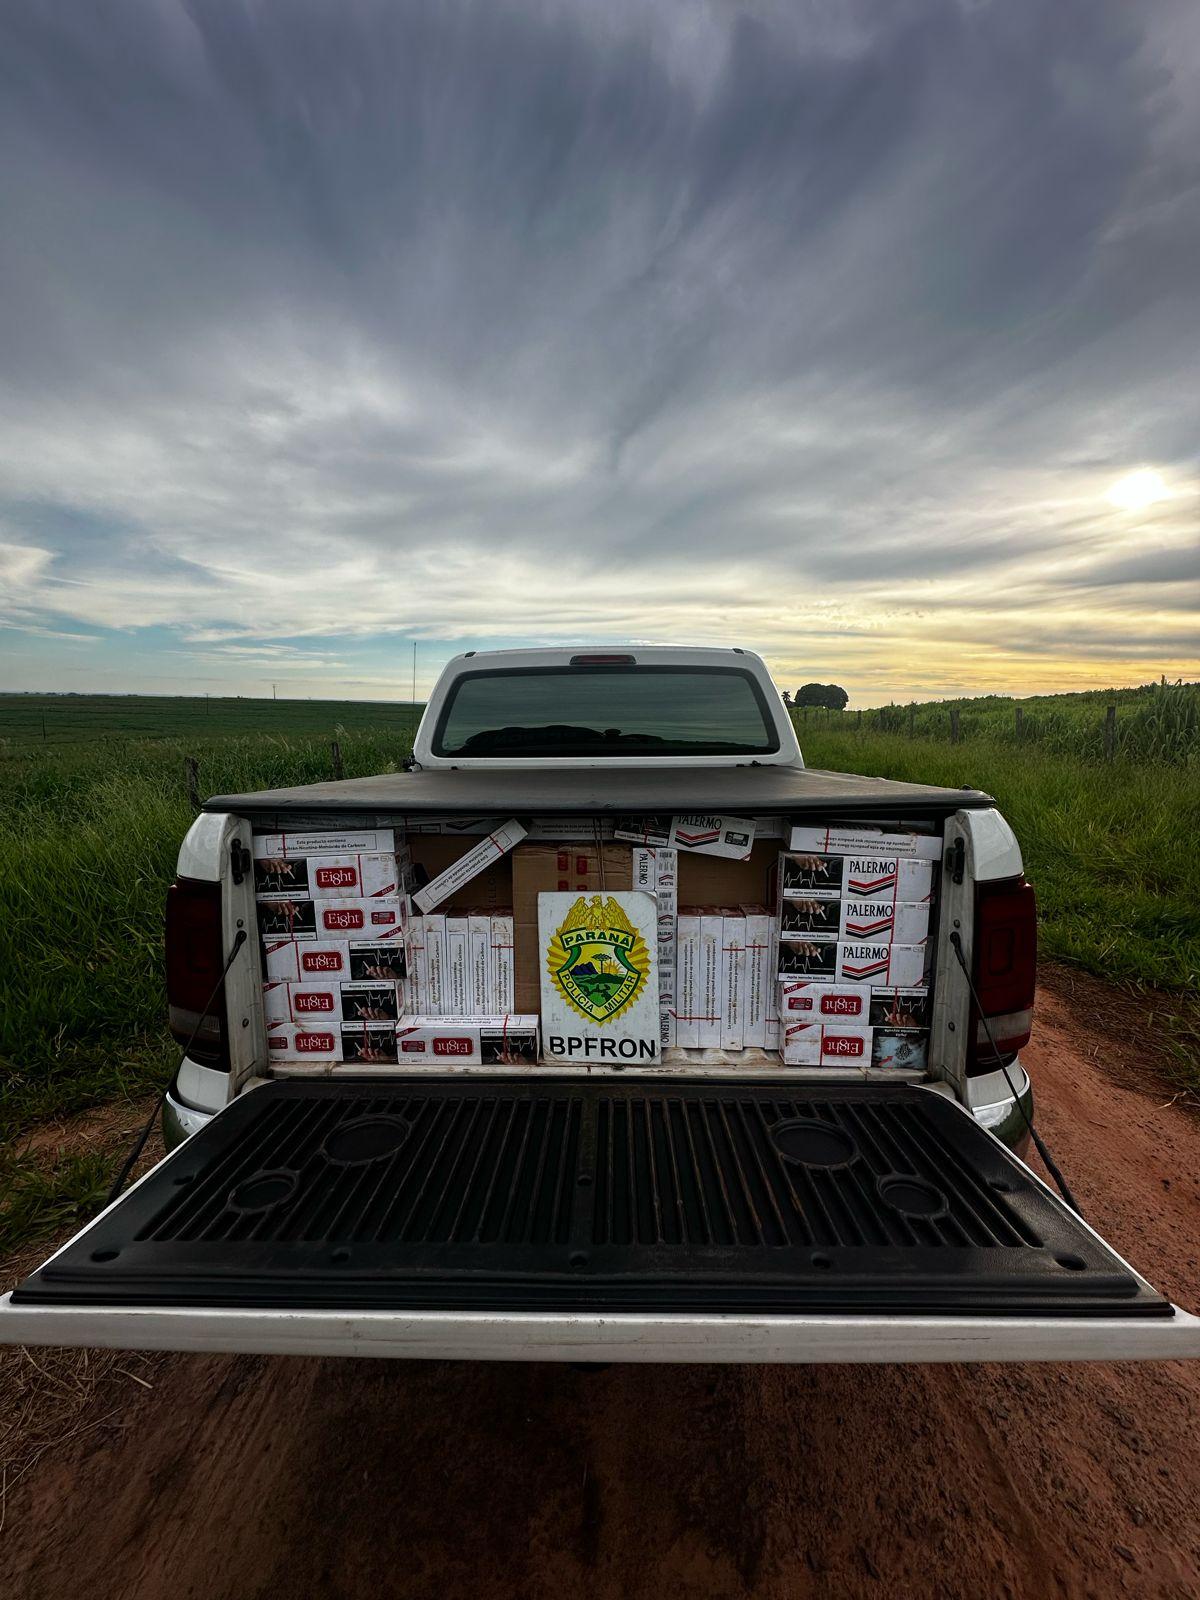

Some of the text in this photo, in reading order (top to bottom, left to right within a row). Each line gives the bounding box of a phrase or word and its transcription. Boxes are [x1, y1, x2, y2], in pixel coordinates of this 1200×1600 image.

[676, 815, 722, 830] PALERMO
[638, 853, 648, 885] PALERMO
[849, 860, 896, 874] PALERMO
[320, 870, 353, 885] Eight
[847, 903, 893, 917] PALERMO
[327, 911, 360, 927] Eight
[564, 930, 630, 948] PARANÁ
[842, 946, 888, 960] PALERMO
[307, 954, 338, 968] Eight
[604, 975, 637, 1013] MILITAR
[298, 995, 330, 1009] Eight
[825, 997, 857, 1013] Eight
[660, 1013, 670, 1044] PALERMO
[299, 1034, 331, 1049] Eight
[437, 1040, 468, 1053] Eight
[549, 1035, 656, 1059] BPFRON
[827, 1039, 860, 1054] Eight
